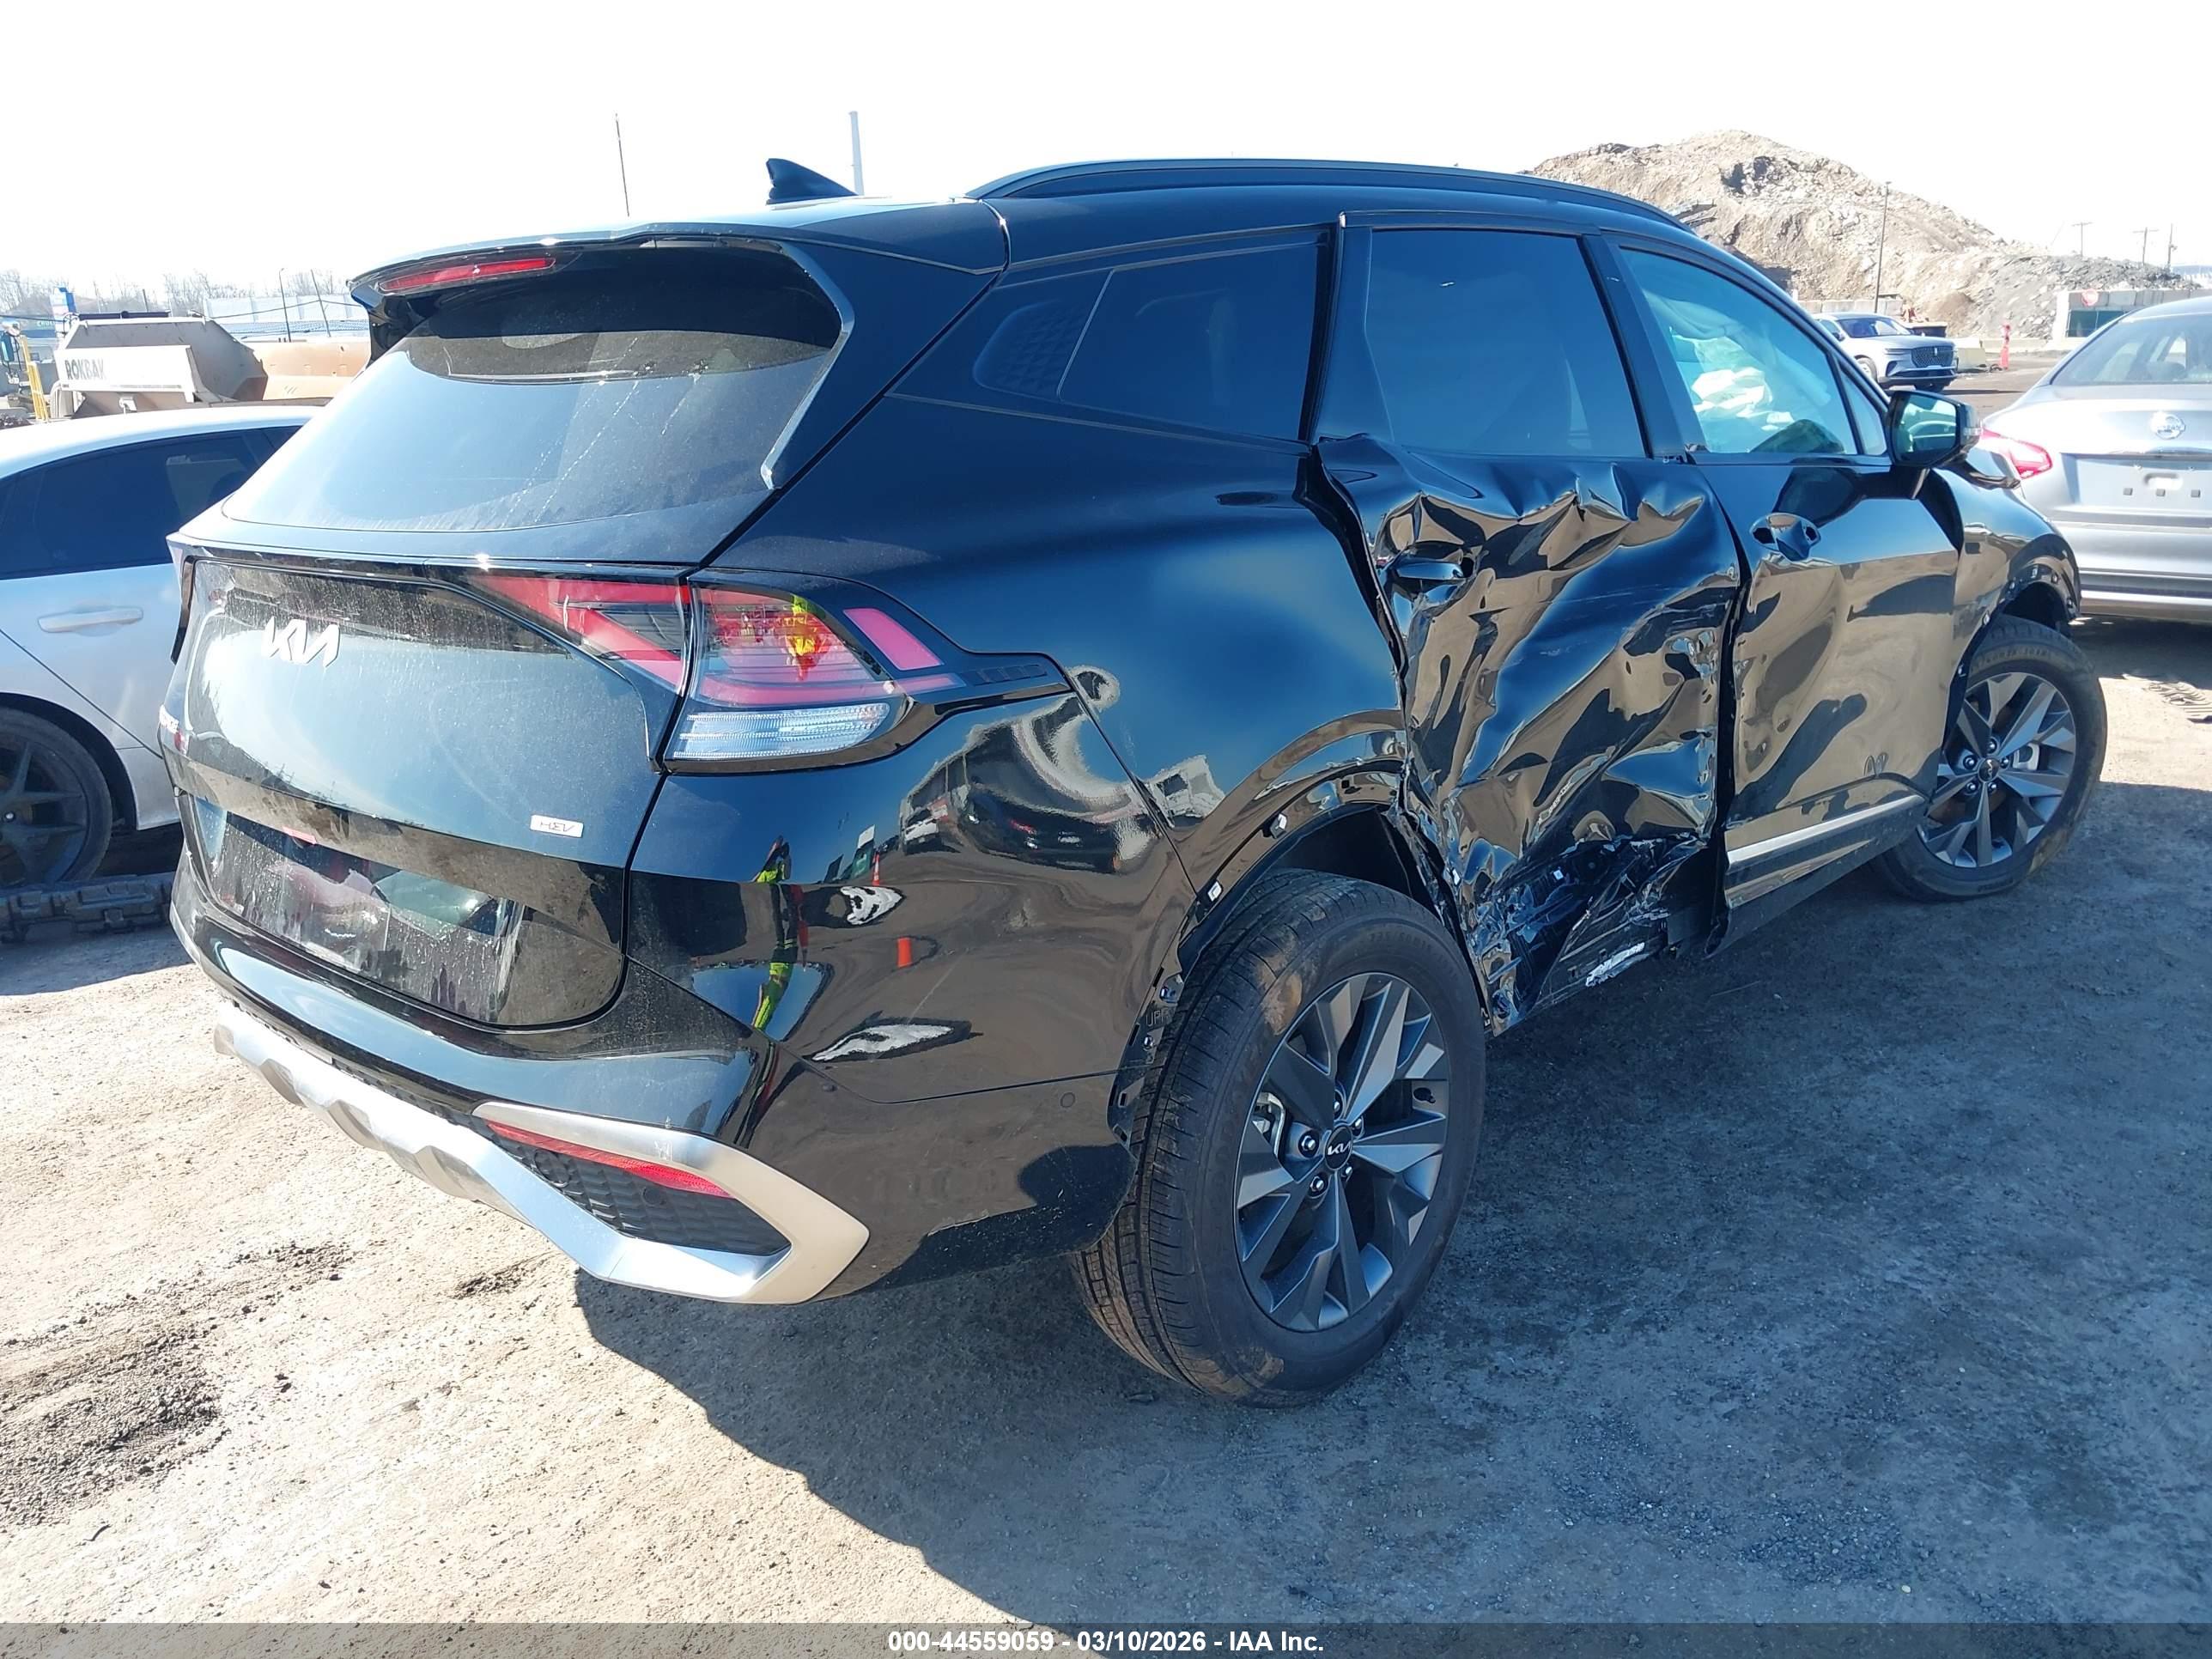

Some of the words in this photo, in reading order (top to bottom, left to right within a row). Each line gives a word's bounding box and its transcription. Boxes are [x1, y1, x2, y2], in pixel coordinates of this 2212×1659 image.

[64, 358, 107, 380] ROKBAK
[261, 616, 341, 668] KIA
[540, 821, 575, 832] HEV
[1328, 1140, 1352, 1156] KIA
